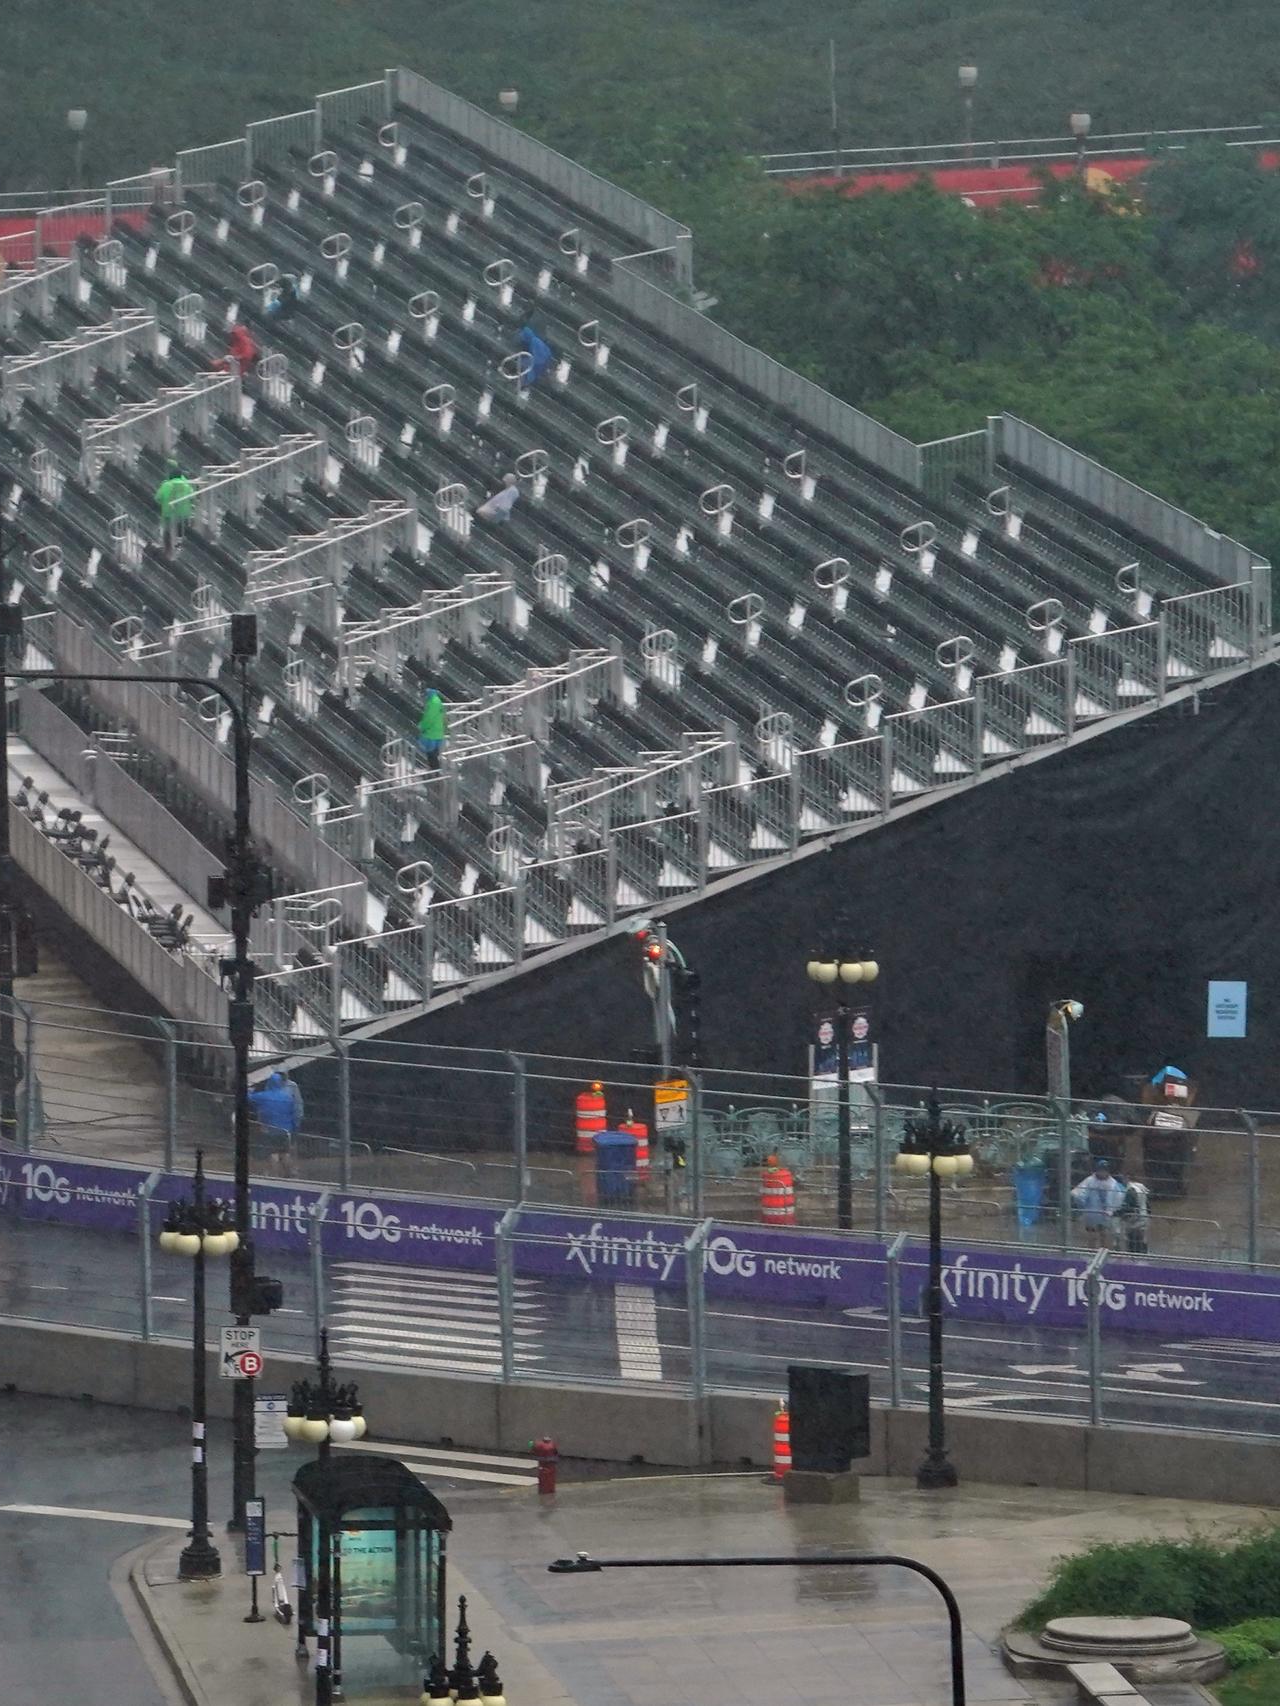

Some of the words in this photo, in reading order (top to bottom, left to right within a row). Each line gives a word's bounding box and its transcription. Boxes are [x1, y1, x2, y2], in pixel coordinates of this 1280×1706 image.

[22, 1163, 70, 1204] 10G
[76, 1184, 138, 1208] network
[340, 1200, 402, 1243] 10G
[409, 1221, 484, 1246] network
[566, 1222, 682, 1281] xfinity
[764, 1256, 841, 1280] network
[1134, 1288, 1214, 1312] network
[225, 1330, 256, 1341] STOP
[245, 1357, 258, 1371] B
